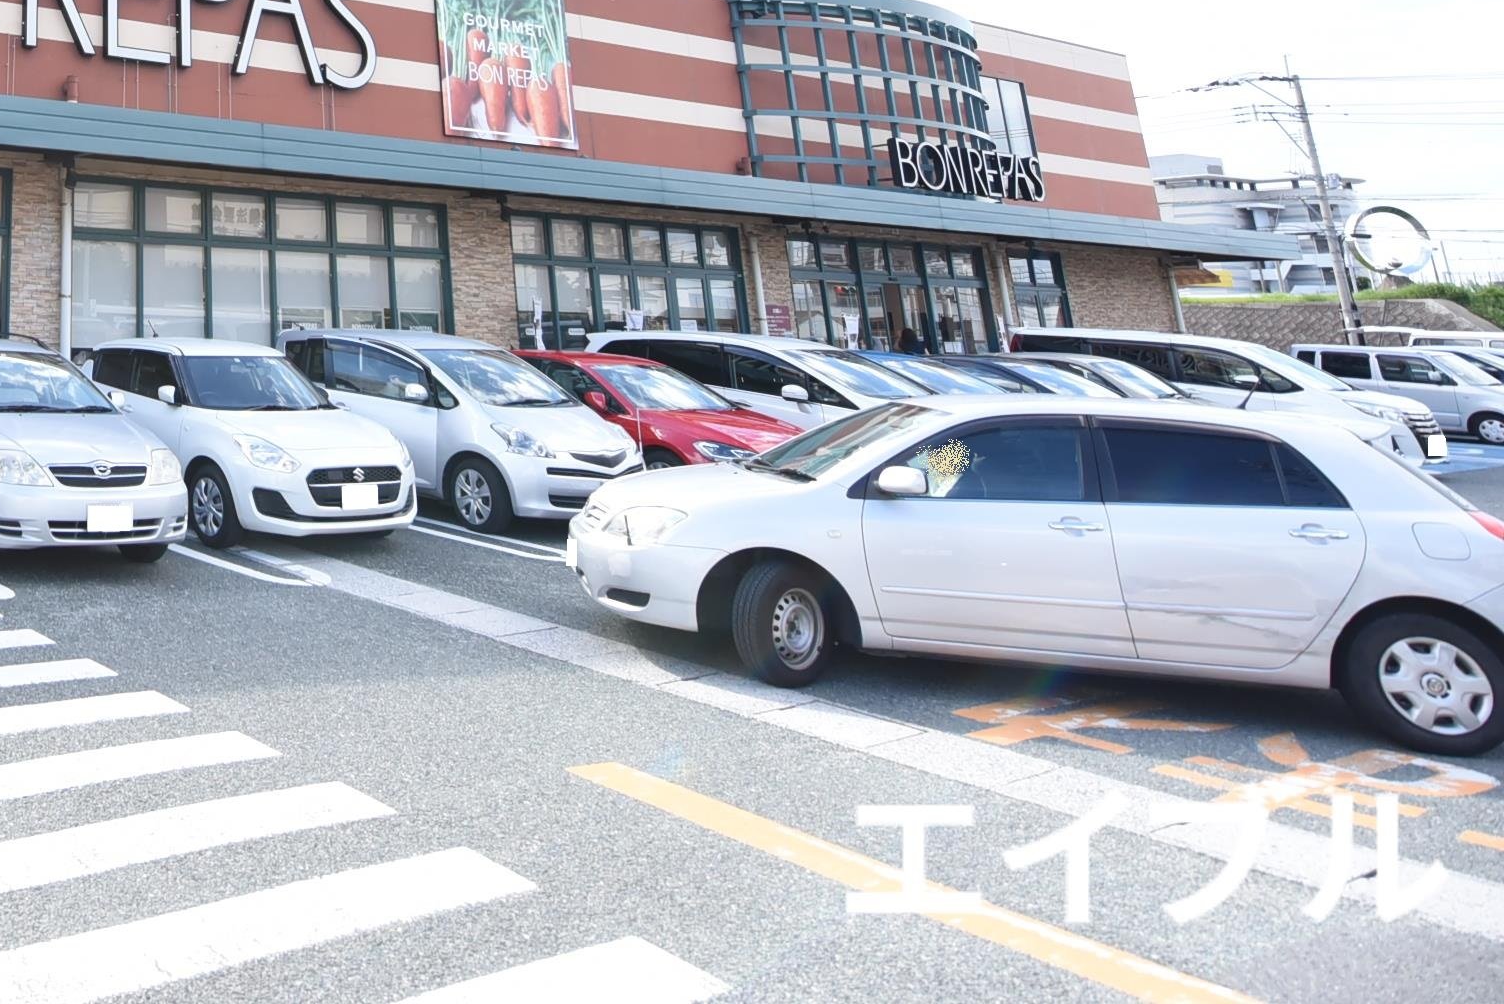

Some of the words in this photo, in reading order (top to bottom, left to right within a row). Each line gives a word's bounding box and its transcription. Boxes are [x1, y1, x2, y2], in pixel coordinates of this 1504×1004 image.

[462, 12, 545, 38] GOURMET
[472, 37, 540, 61] MARKET
[468, 61, 504, 85] BON
[507, 67, 548, 91] REPAS
